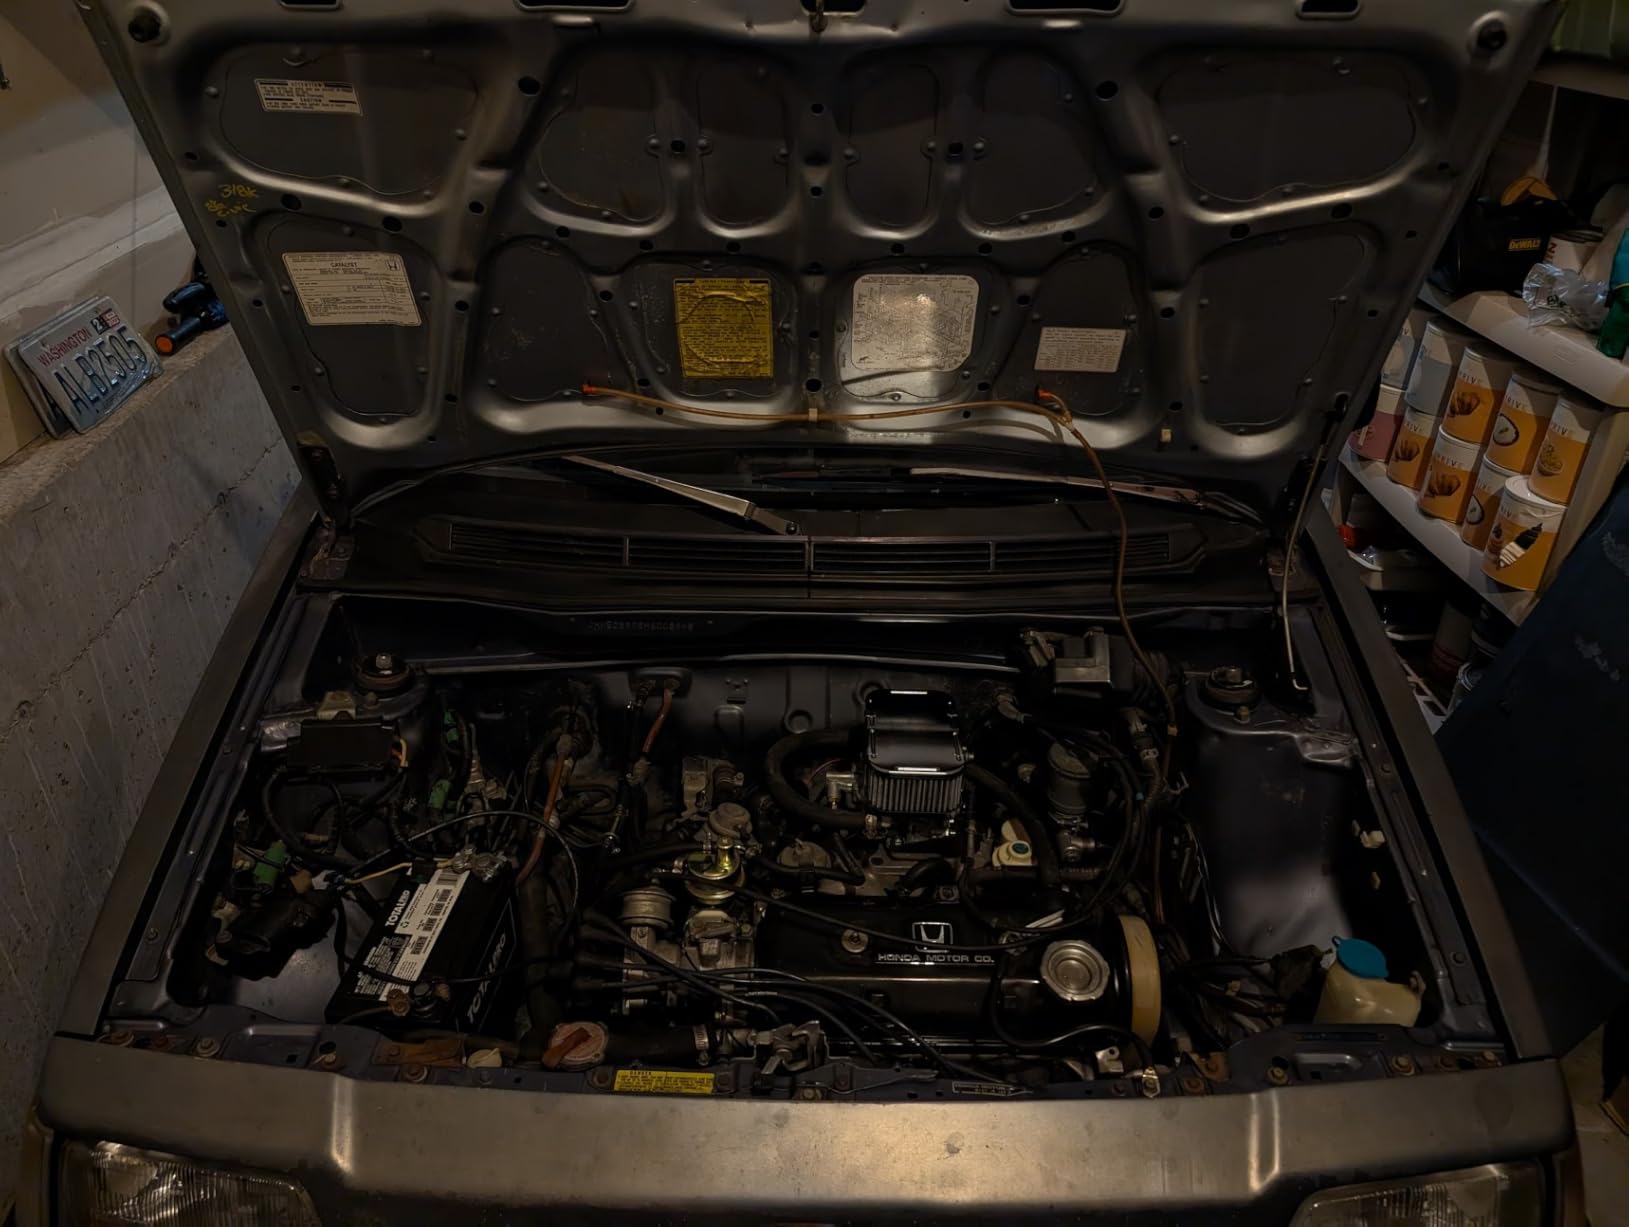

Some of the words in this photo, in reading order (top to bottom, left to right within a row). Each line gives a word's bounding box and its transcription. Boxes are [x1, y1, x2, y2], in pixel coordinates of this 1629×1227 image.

[38, 327, 92, 366] WASHINGTON
[54, 325, 148, 415] ALB2505
[877, 953, 921, 962] HONDA
[925, 954, 970, 963] MOTOR
[973, 954, 996, 963] CO.
